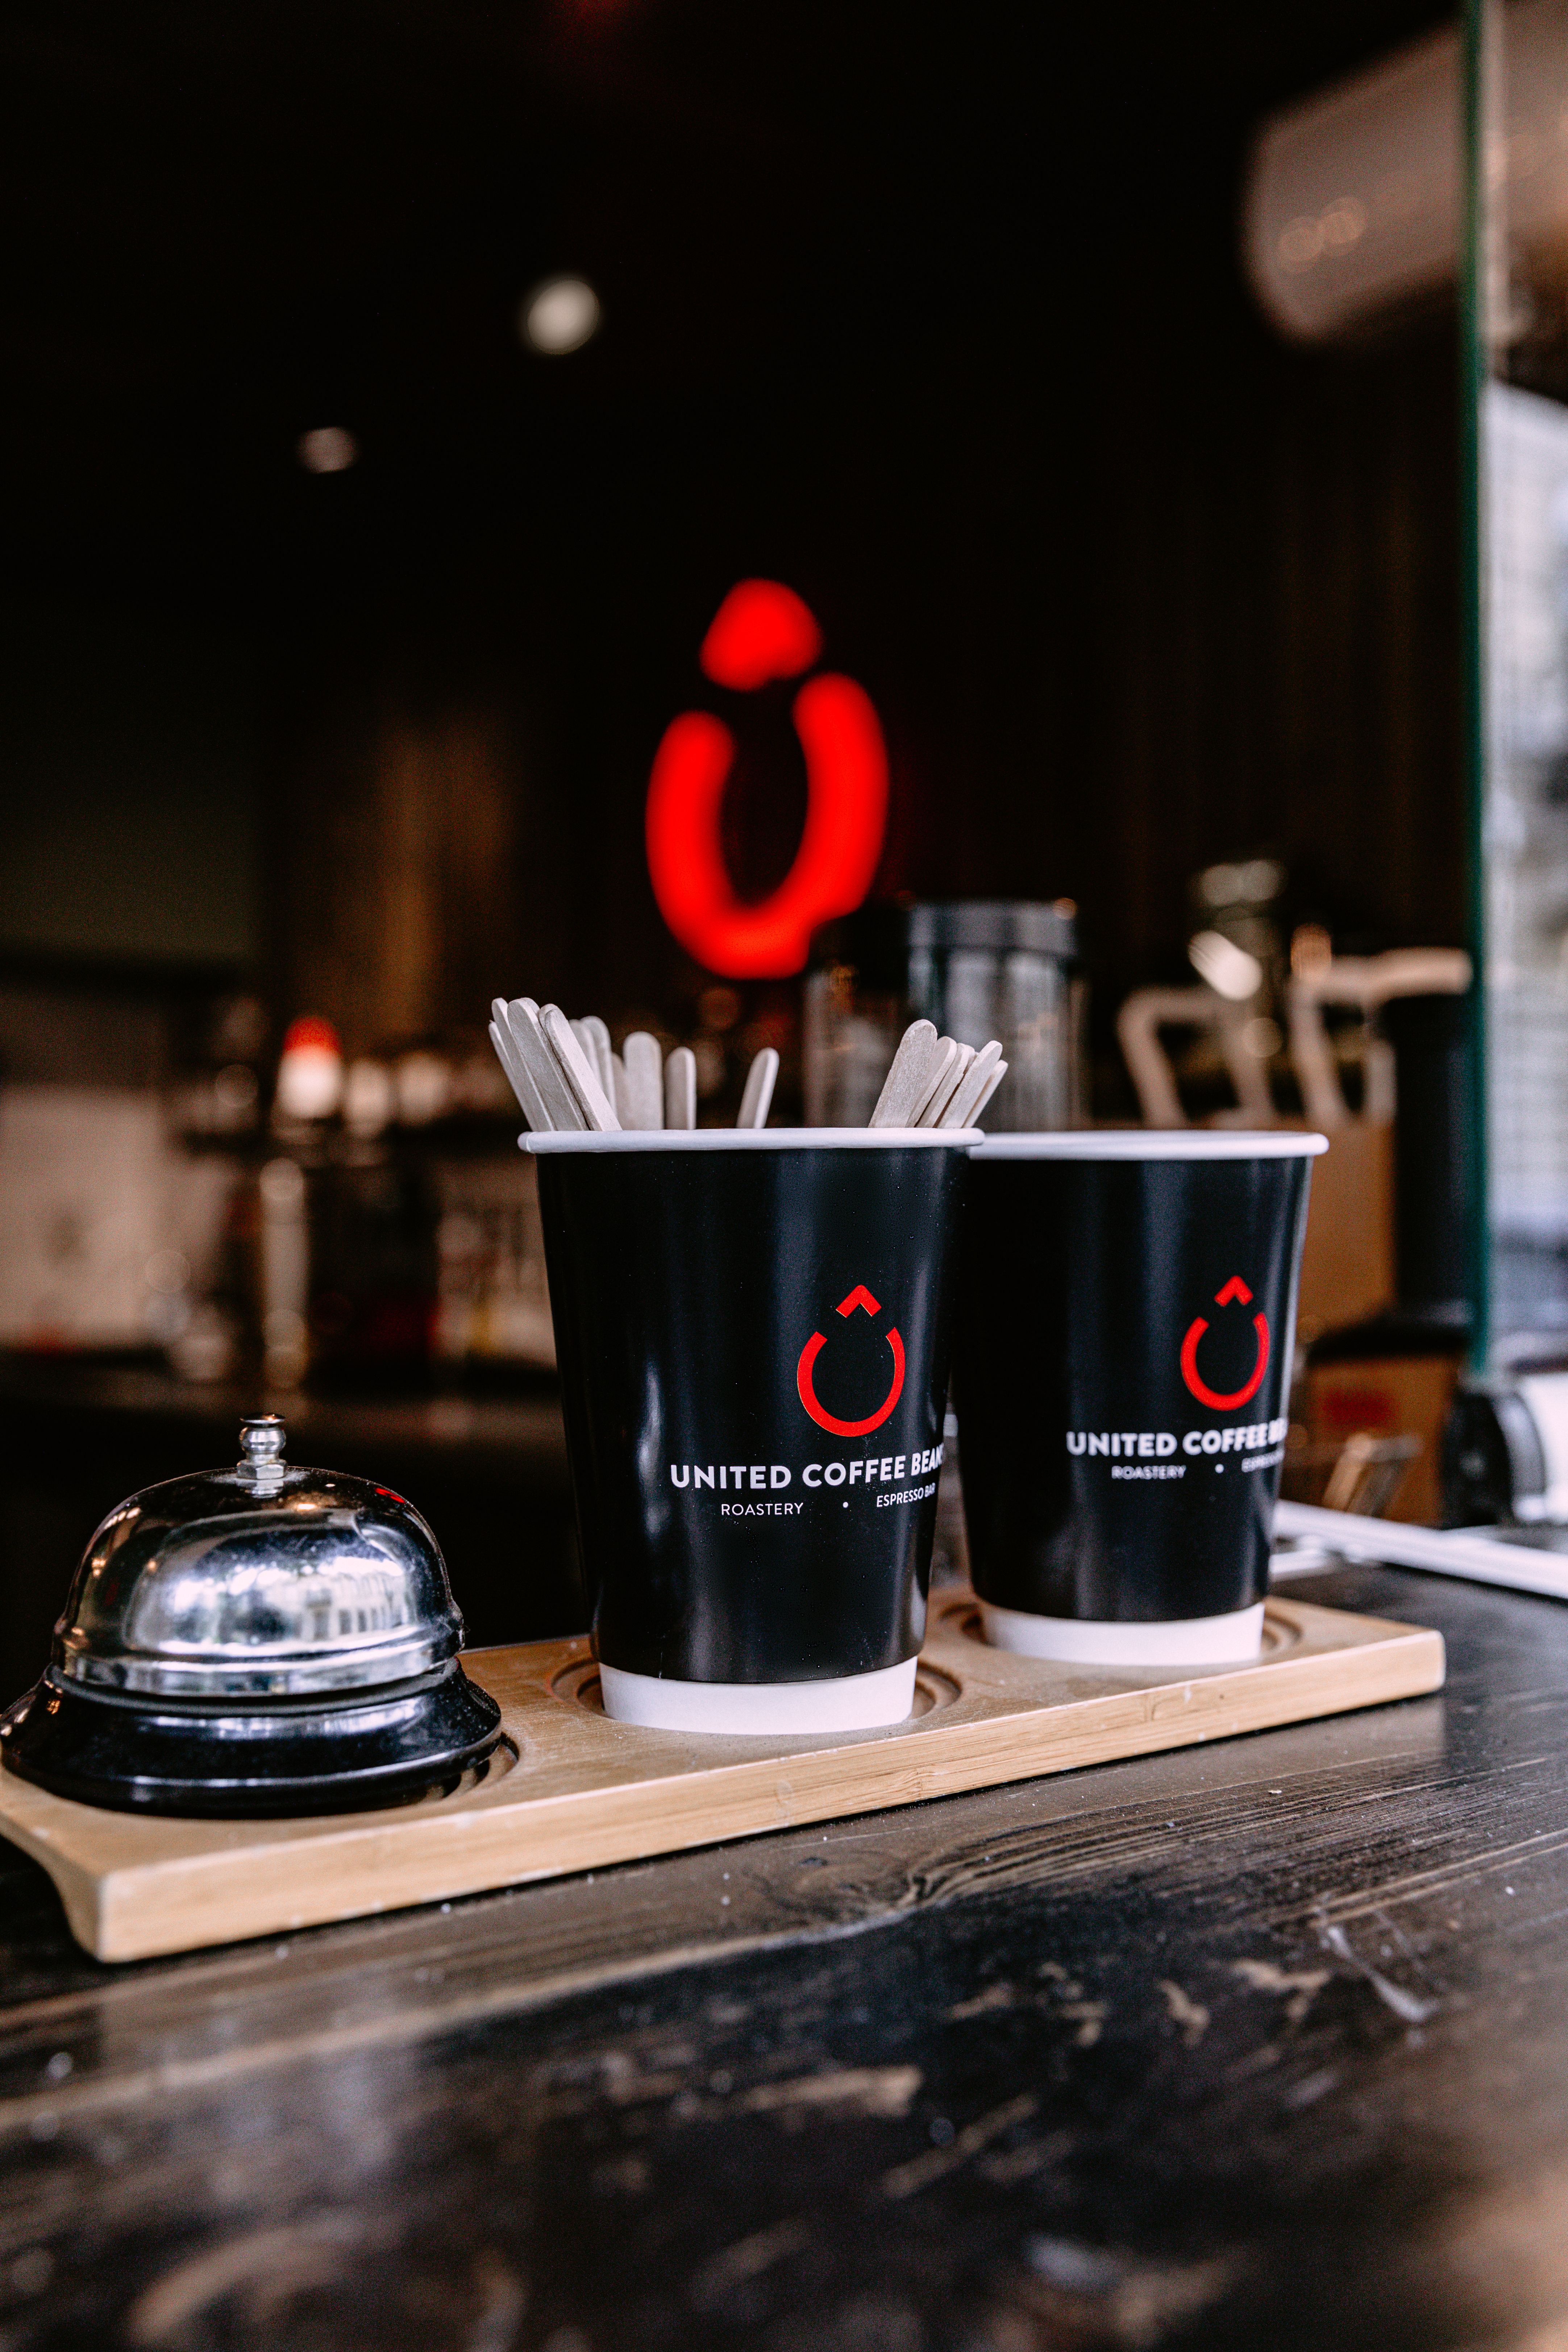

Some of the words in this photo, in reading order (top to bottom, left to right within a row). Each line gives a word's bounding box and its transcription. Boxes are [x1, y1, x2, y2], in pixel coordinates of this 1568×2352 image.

[1066, 1431, 1177, 1456] UNITED
[1182, 1423, 1268, 1455] COFFEE
[670, 1464, 791, 1489] UNITED
[802, 1456, 906, 1487] COFFEE
[911, 1442, 944, 1476] BEAN
[1111, 1465, 1187, 1479] ROASTERY
[721, 1502, 804, 1516] ROASTERY
[876, 1487, 924, 1508] ESPRESSO
[924, 1482, 936, 1498] BAR
